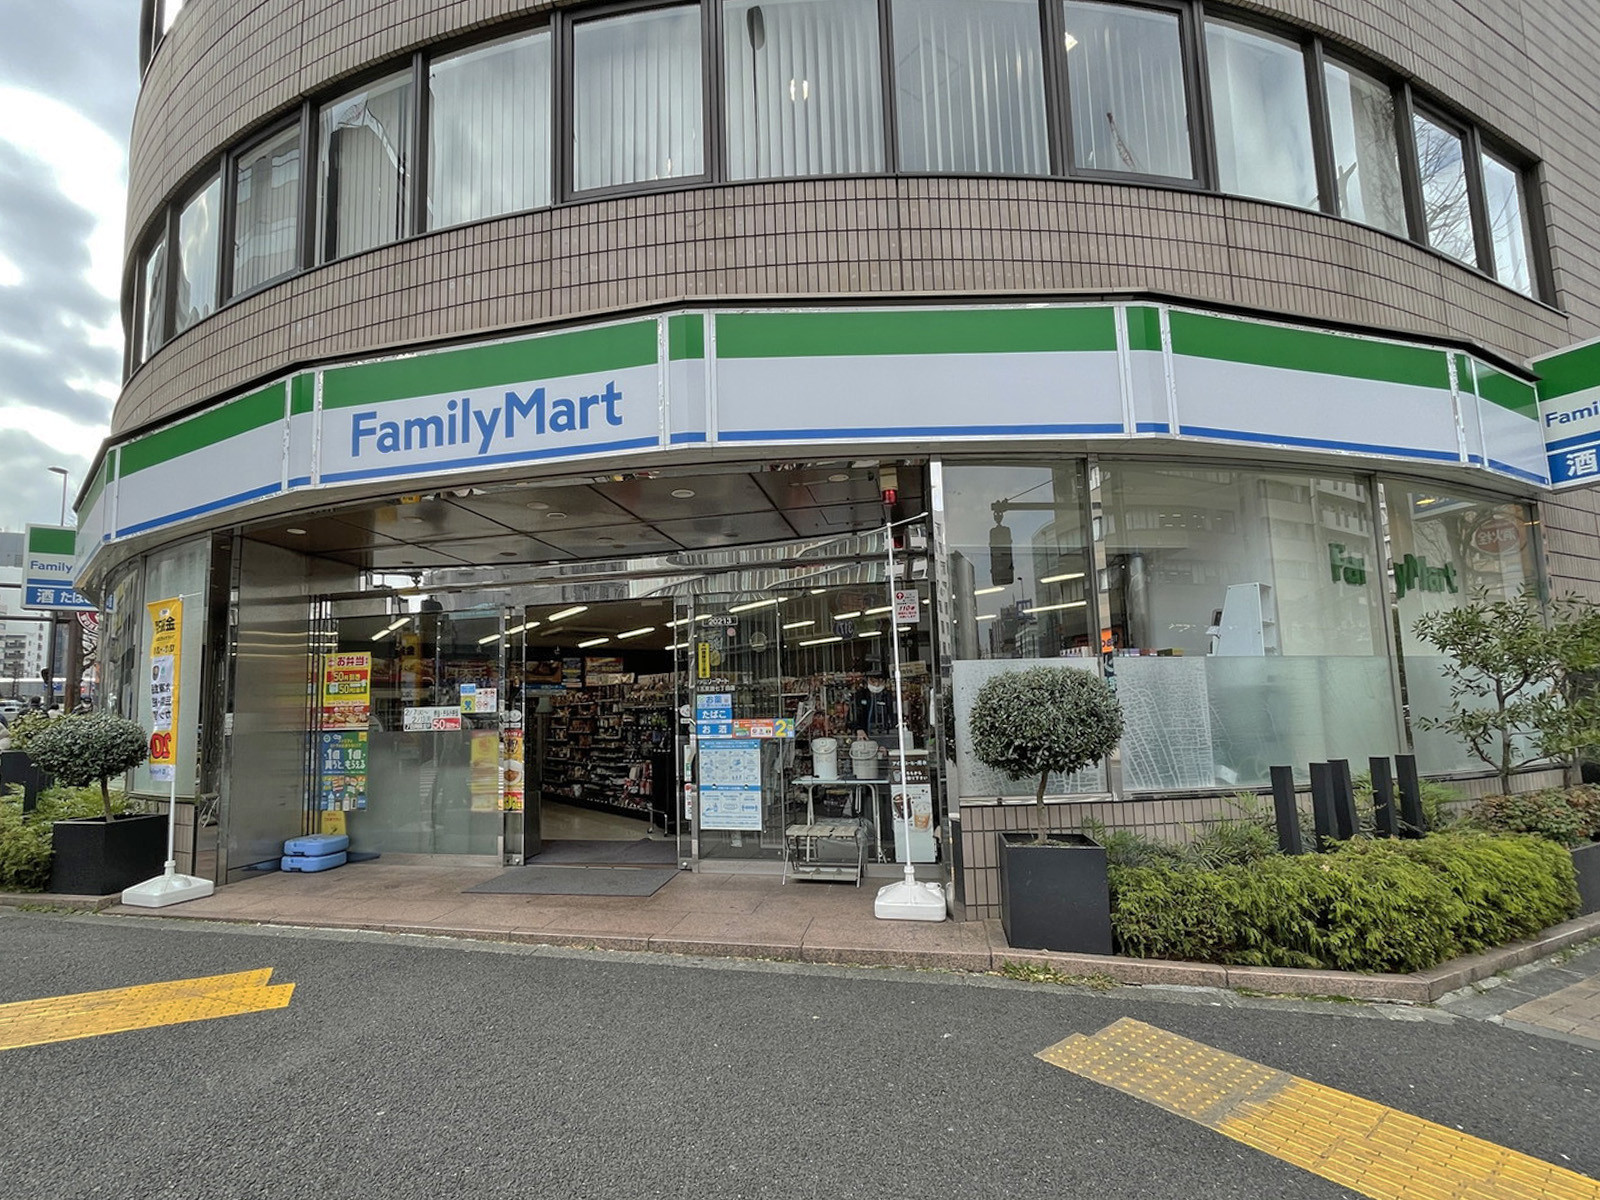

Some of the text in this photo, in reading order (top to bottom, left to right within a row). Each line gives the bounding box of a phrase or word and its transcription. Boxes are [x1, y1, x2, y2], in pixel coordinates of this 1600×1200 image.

[351, 380, 623, 457] FamilyMart
[1545, 401, 1599, 427] Fami
[1566, 449, 1598, 476] 酒
[30, 560, 73, 573] Family
[36, 588, 55, 604] 酒
[337, 656, 364, 667] お弁当
[702, 710, 727, 719] たばこ
